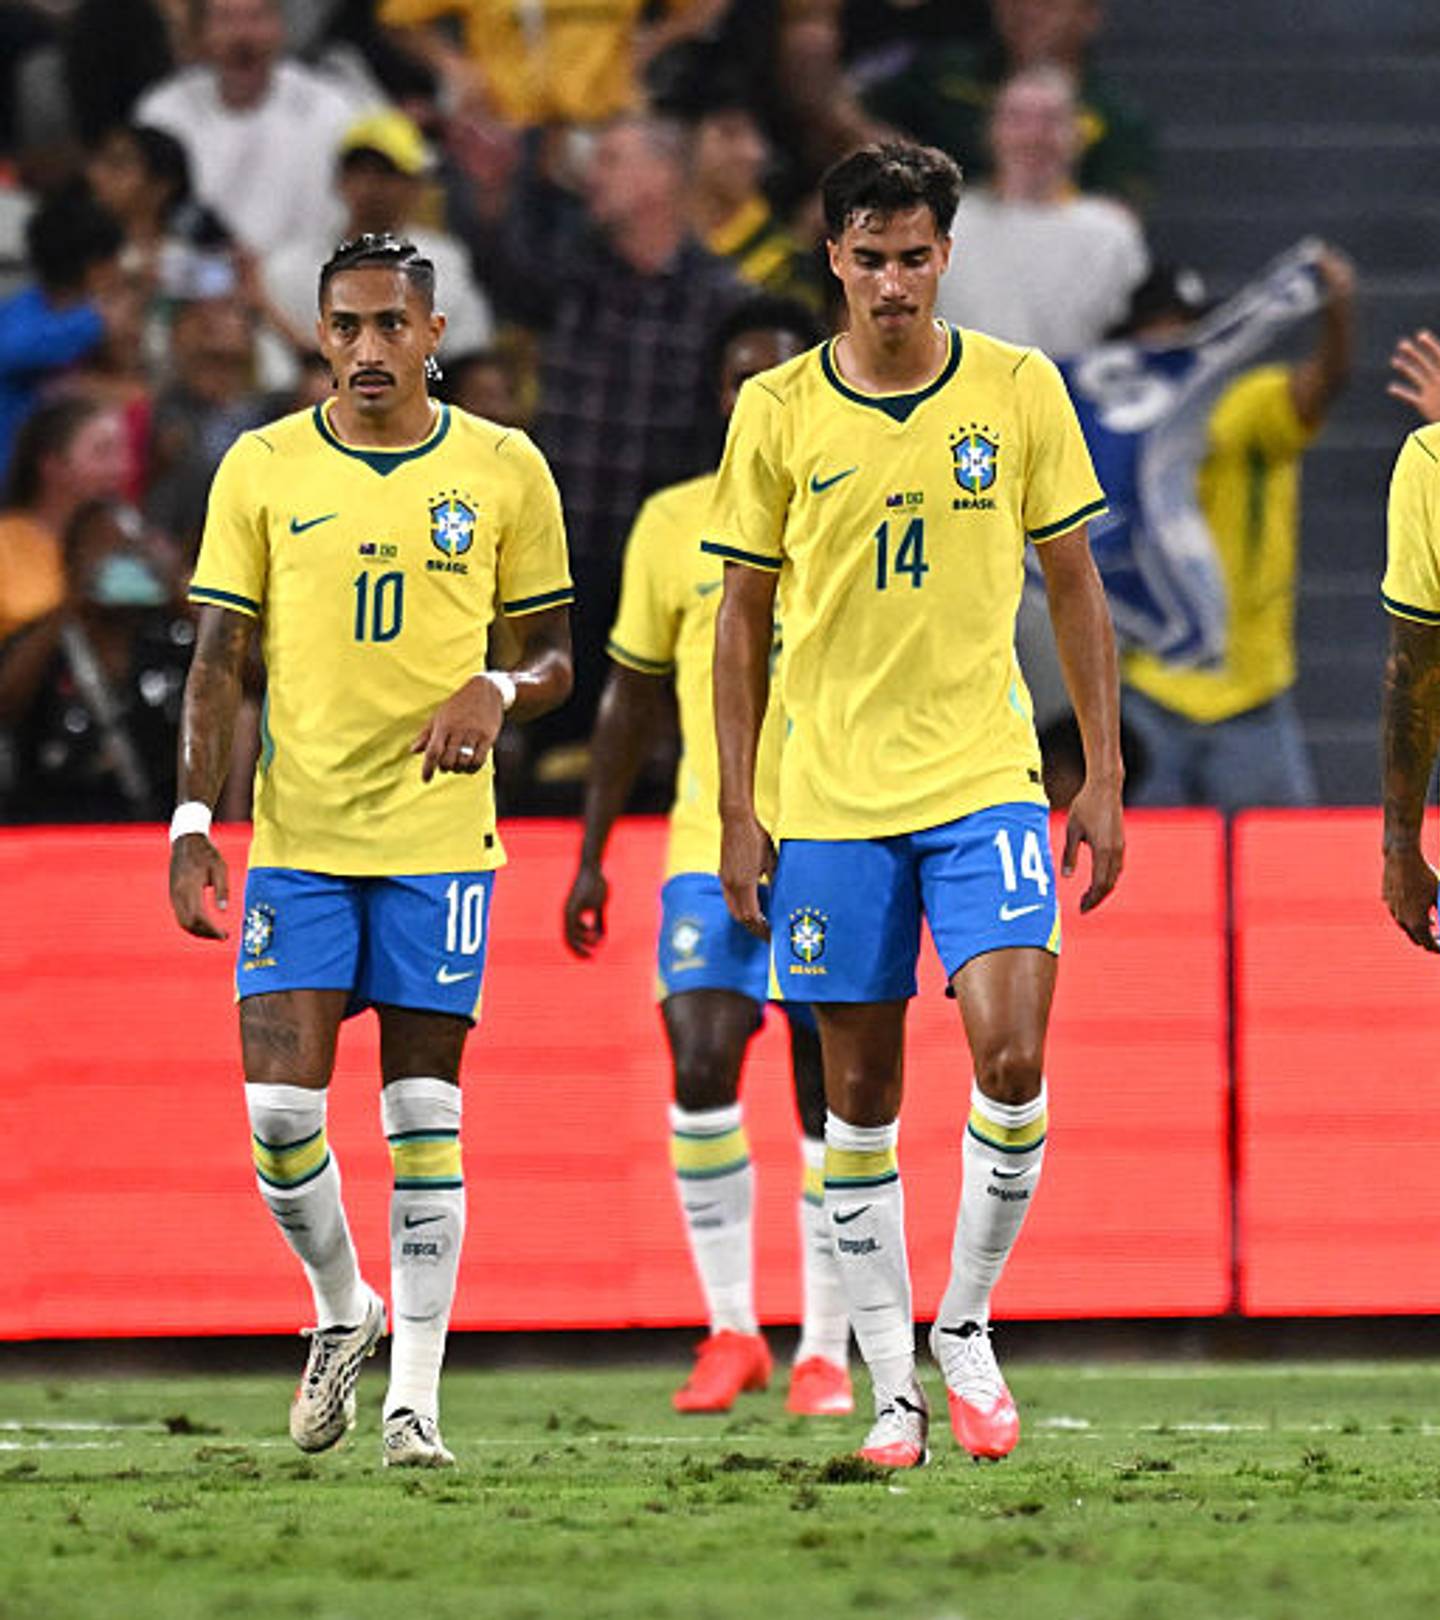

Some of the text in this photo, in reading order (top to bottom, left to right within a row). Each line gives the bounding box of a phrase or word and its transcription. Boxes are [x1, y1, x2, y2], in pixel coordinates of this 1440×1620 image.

[874, 517, 929, 591] 14
[354, 570, 405, 642] 10
[993, 828, 1050, 897] 14
[444, 879, 486, 956] 10
